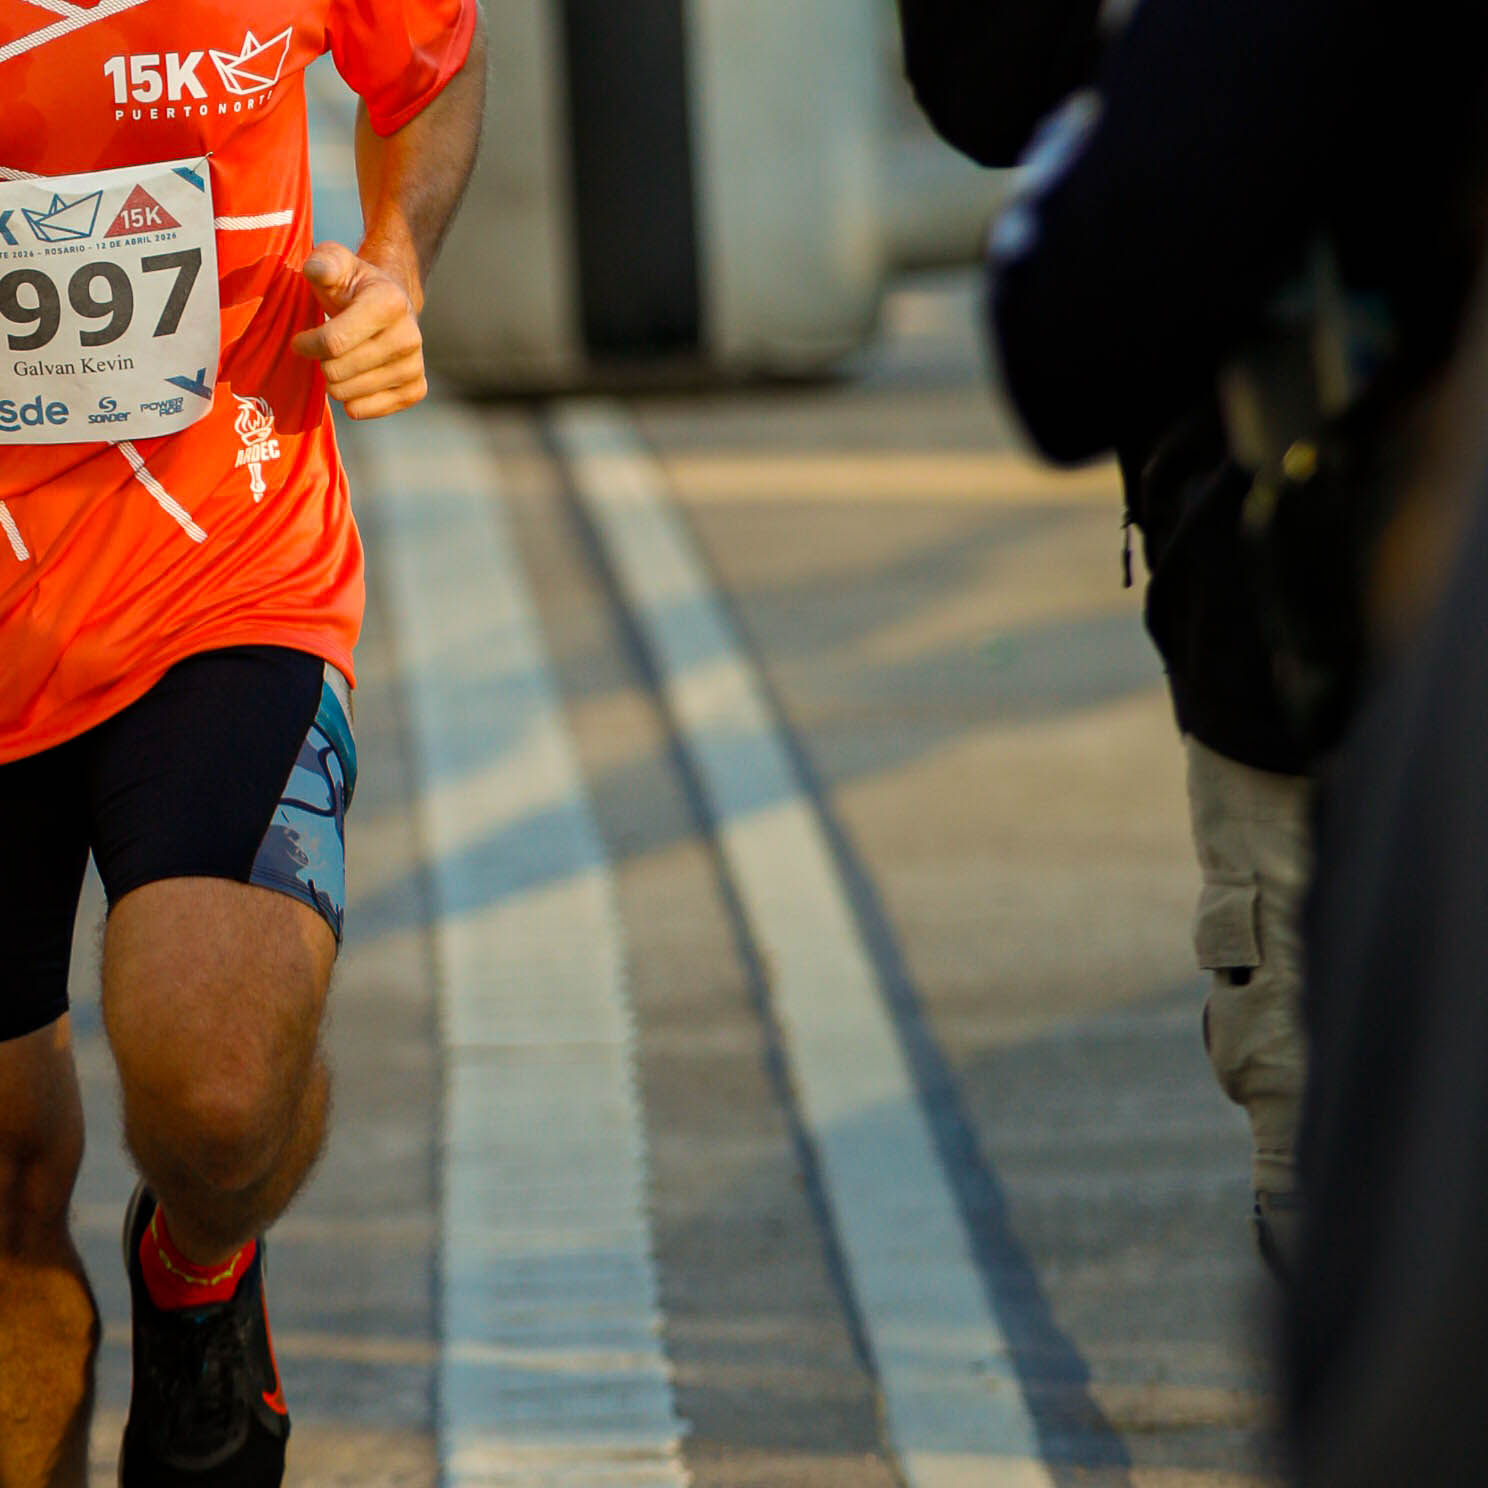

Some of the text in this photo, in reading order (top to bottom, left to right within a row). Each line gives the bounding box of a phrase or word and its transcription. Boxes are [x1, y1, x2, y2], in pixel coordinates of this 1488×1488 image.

[104, 50, 209, 105] 15K
[115, 105, 208, 121] PUERTO
[120, 205, 164, 229] 15K
[44, 244, 86, 257] ROSARIO
[96, 241, 107, 251] 12
[109, 239, 122, 249] DE
[125, 235, 152, 247] ABRIL
[155, 231, 178, 243] 2026
[13, 354, 135, 377] Galvan Kevin
